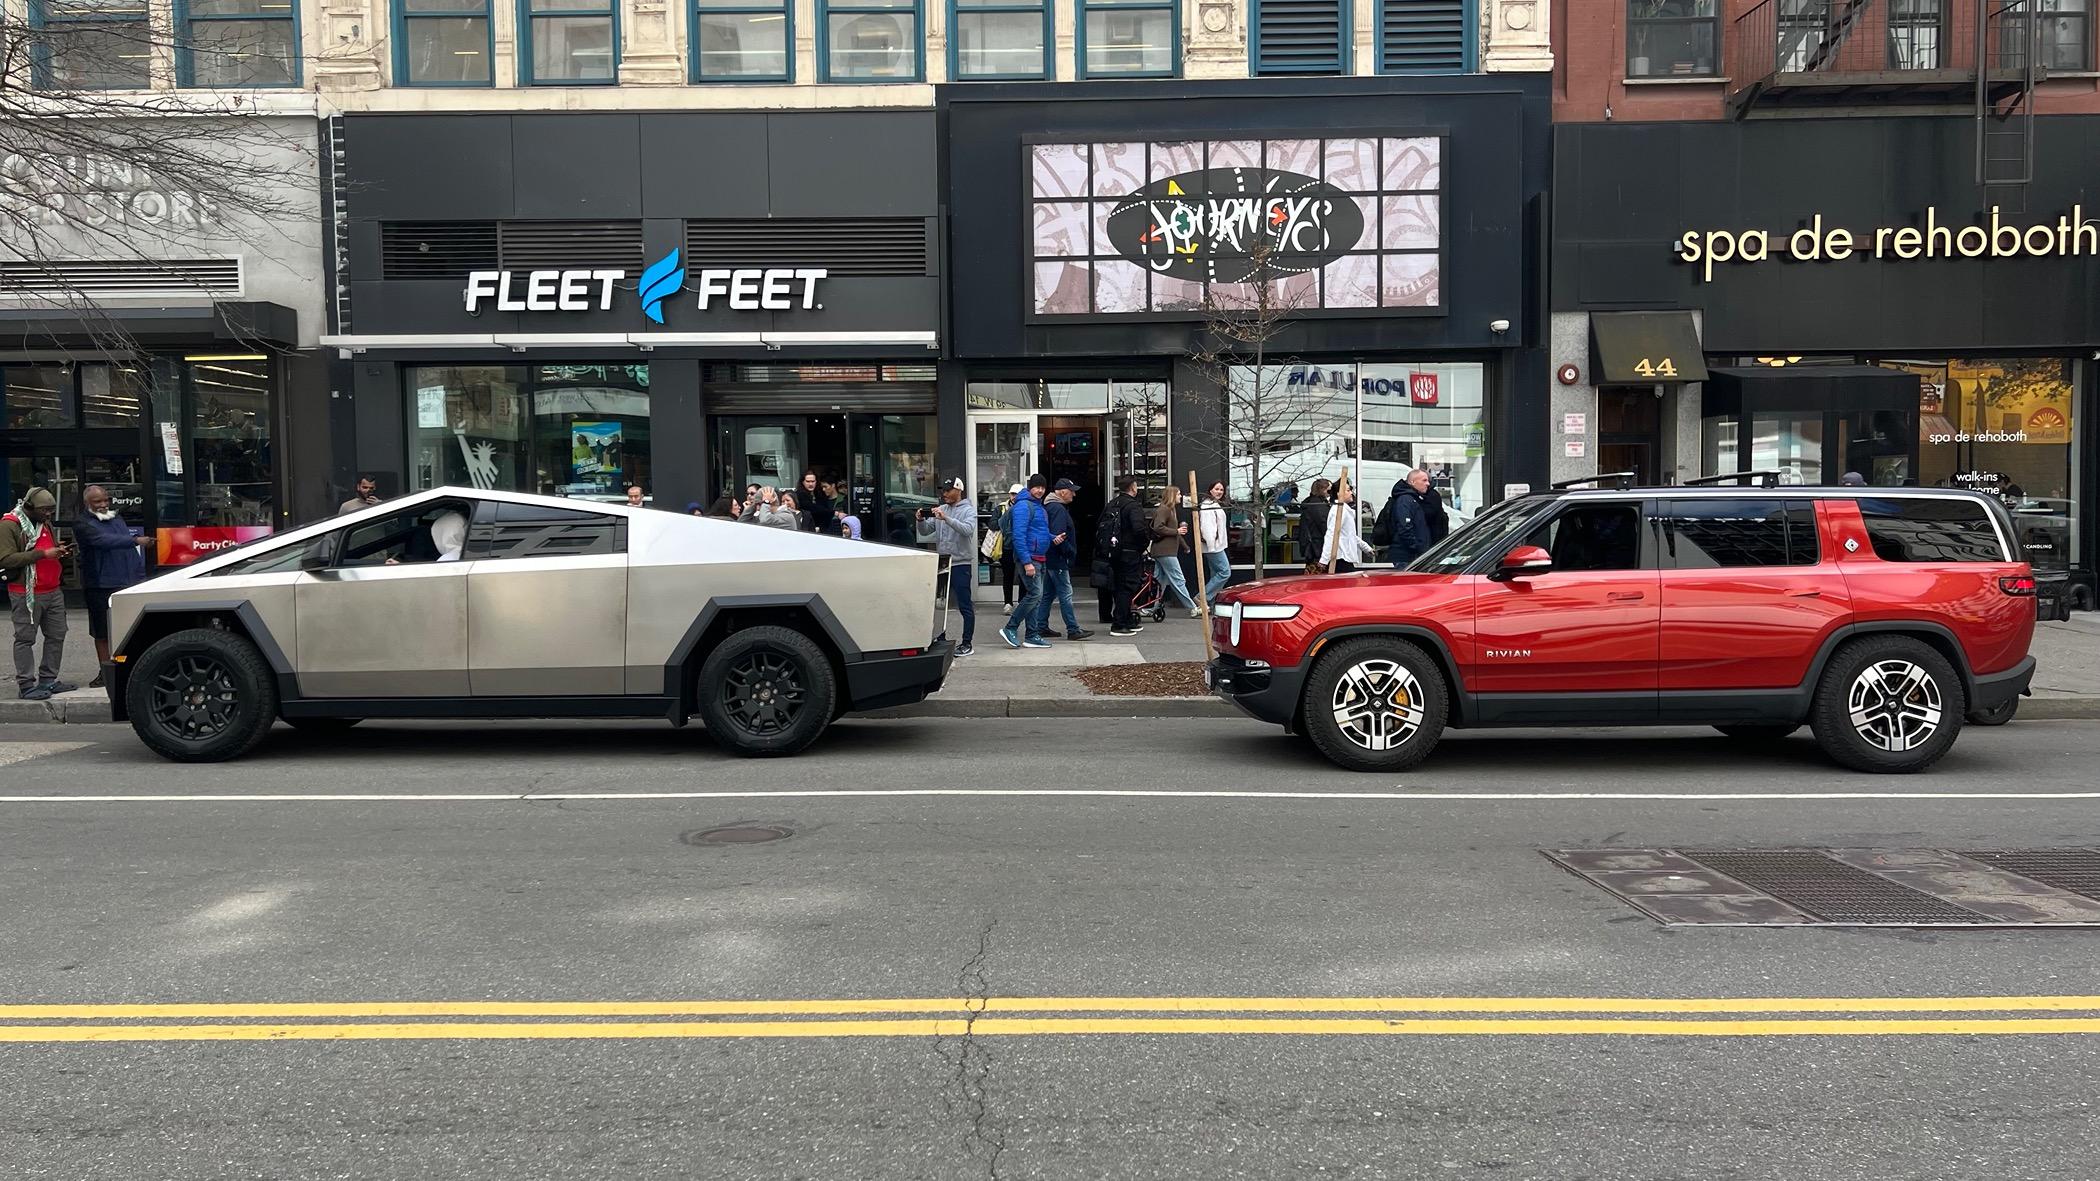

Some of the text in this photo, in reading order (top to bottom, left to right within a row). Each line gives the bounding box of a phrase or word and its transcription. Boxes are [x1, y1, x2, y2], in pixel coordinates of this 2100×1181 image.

[1138, 177, 1332, 271] JOURNEYS
[1680, 204, 2098, 282] spa de rehoboth
[465, 269, 625, 312] FLEET
[1634, 358, 1678, 377] 44
[1929, 434, 1951, 445] spa
[1955, 430, 1970, 443] de
[1974, 430, 2027, 443] rehoboth
[1956, 470, 1998, 482] walk-ins
[1486, 650, 1531, 658] RIVIAN
